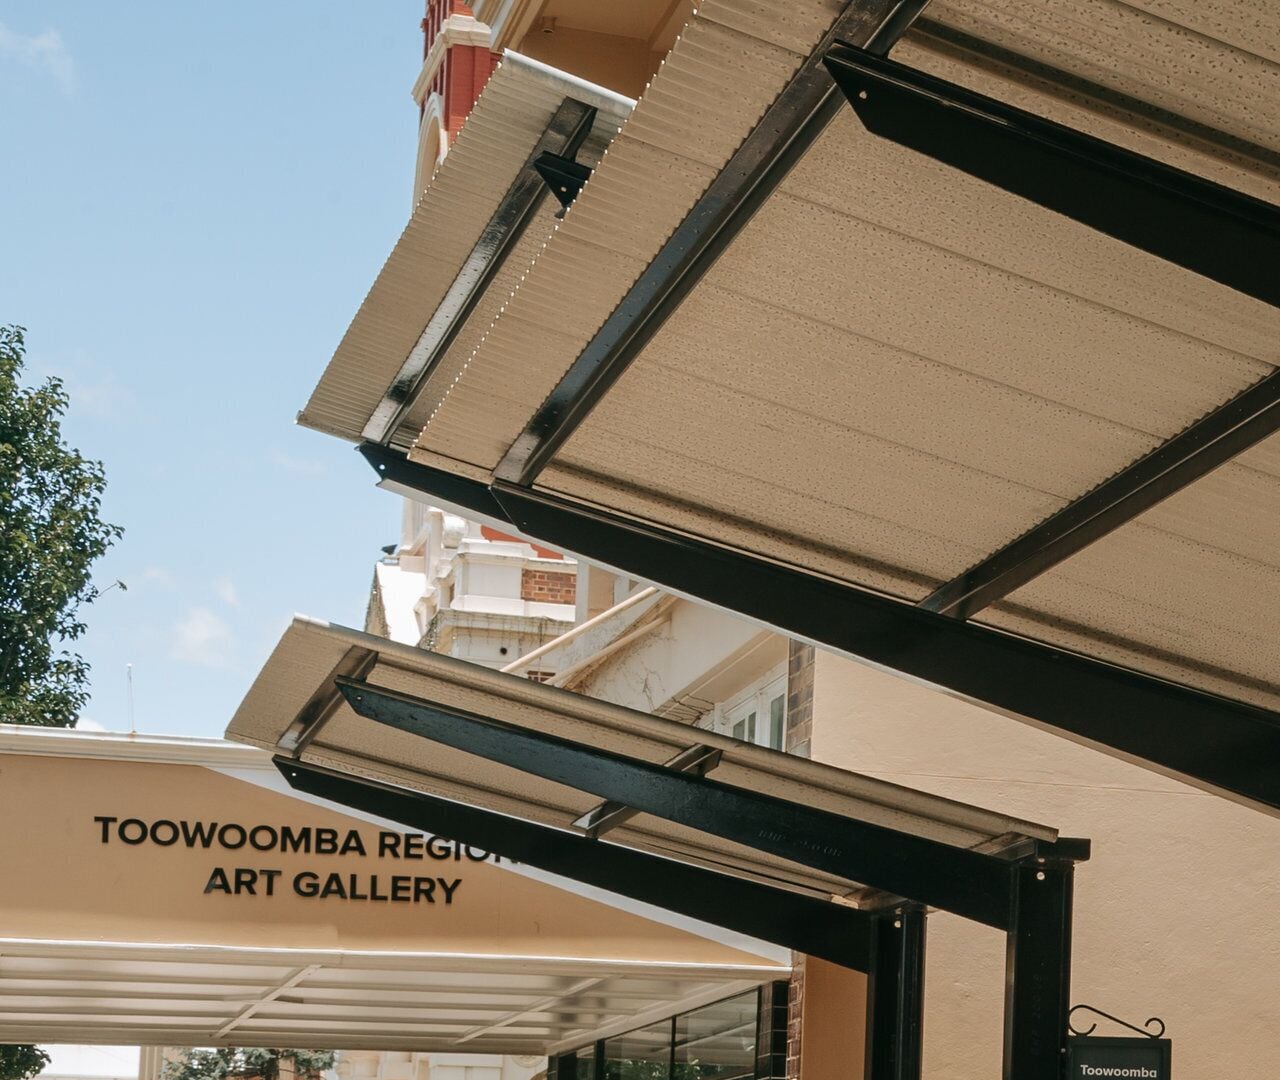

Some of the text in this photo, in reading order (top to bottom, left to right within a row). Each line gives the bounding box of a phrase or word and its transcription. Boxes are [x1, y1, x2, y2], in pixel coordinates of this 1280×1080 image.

[94, 816, 519, 864] TOOWOOMBA REGIO
[204, 868, 462, 905] ART GALLERY
[1080, 1064, 1157, 1078] Toowoomba
